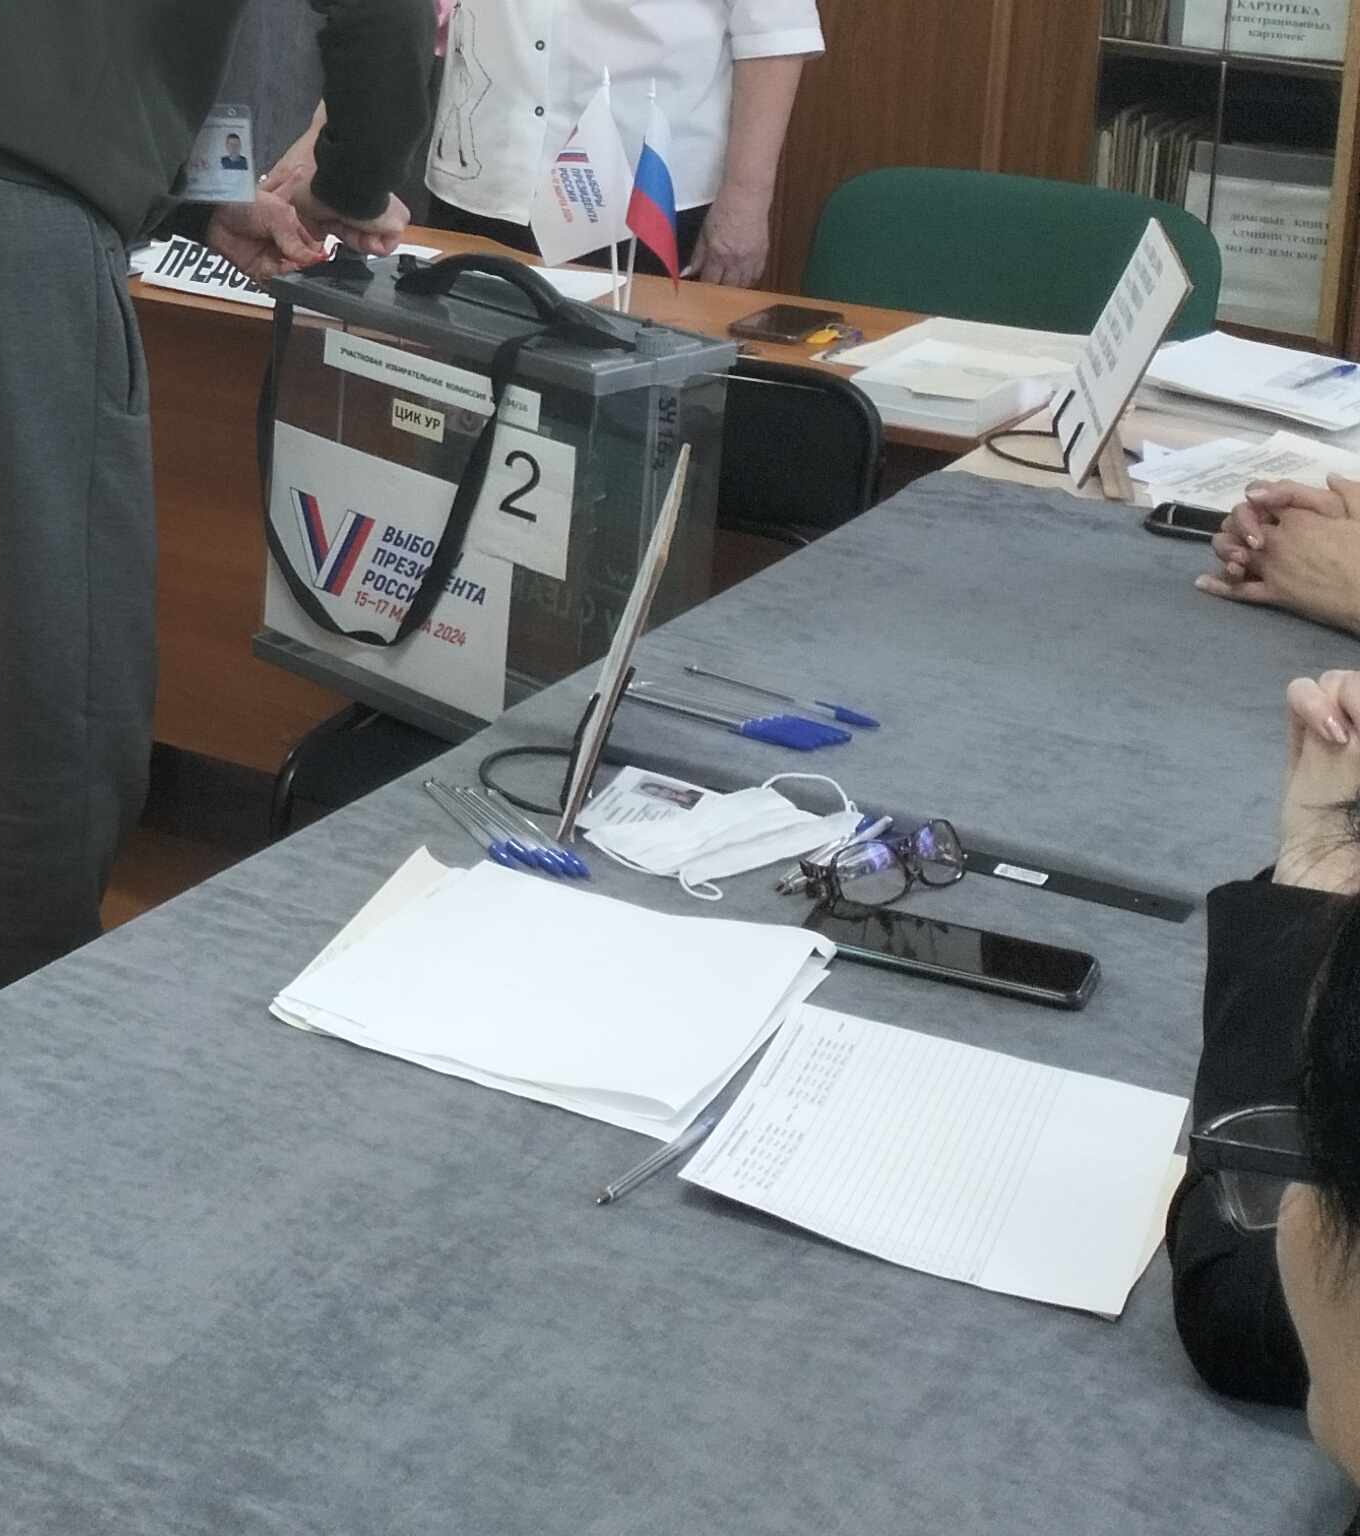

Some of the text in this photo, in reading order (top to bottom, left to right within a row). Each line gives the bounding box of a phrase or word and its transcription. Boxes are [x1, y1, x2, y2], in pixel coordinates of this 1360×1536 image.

[1237, 0, 1321, 16] КАРТОТЕКА
[558, 167, 579, 203] РОССИИ
[154, 239, 264, 294] ПРЕДС
[340, 346, 383, 367] УЧАСТКОВАЯ
[385, 364, 443, 388] ИЗБИРАТЕЛЬНАЯ
[395, 405, 441, 431] ЦИК УР
[499, 450, 541, 523] 2
[361, 568, 417, 604] РОССИ
[371, 547, 487, 606] ПРЕЗИЕНТА
[433, 622, 467, 647] 2024
